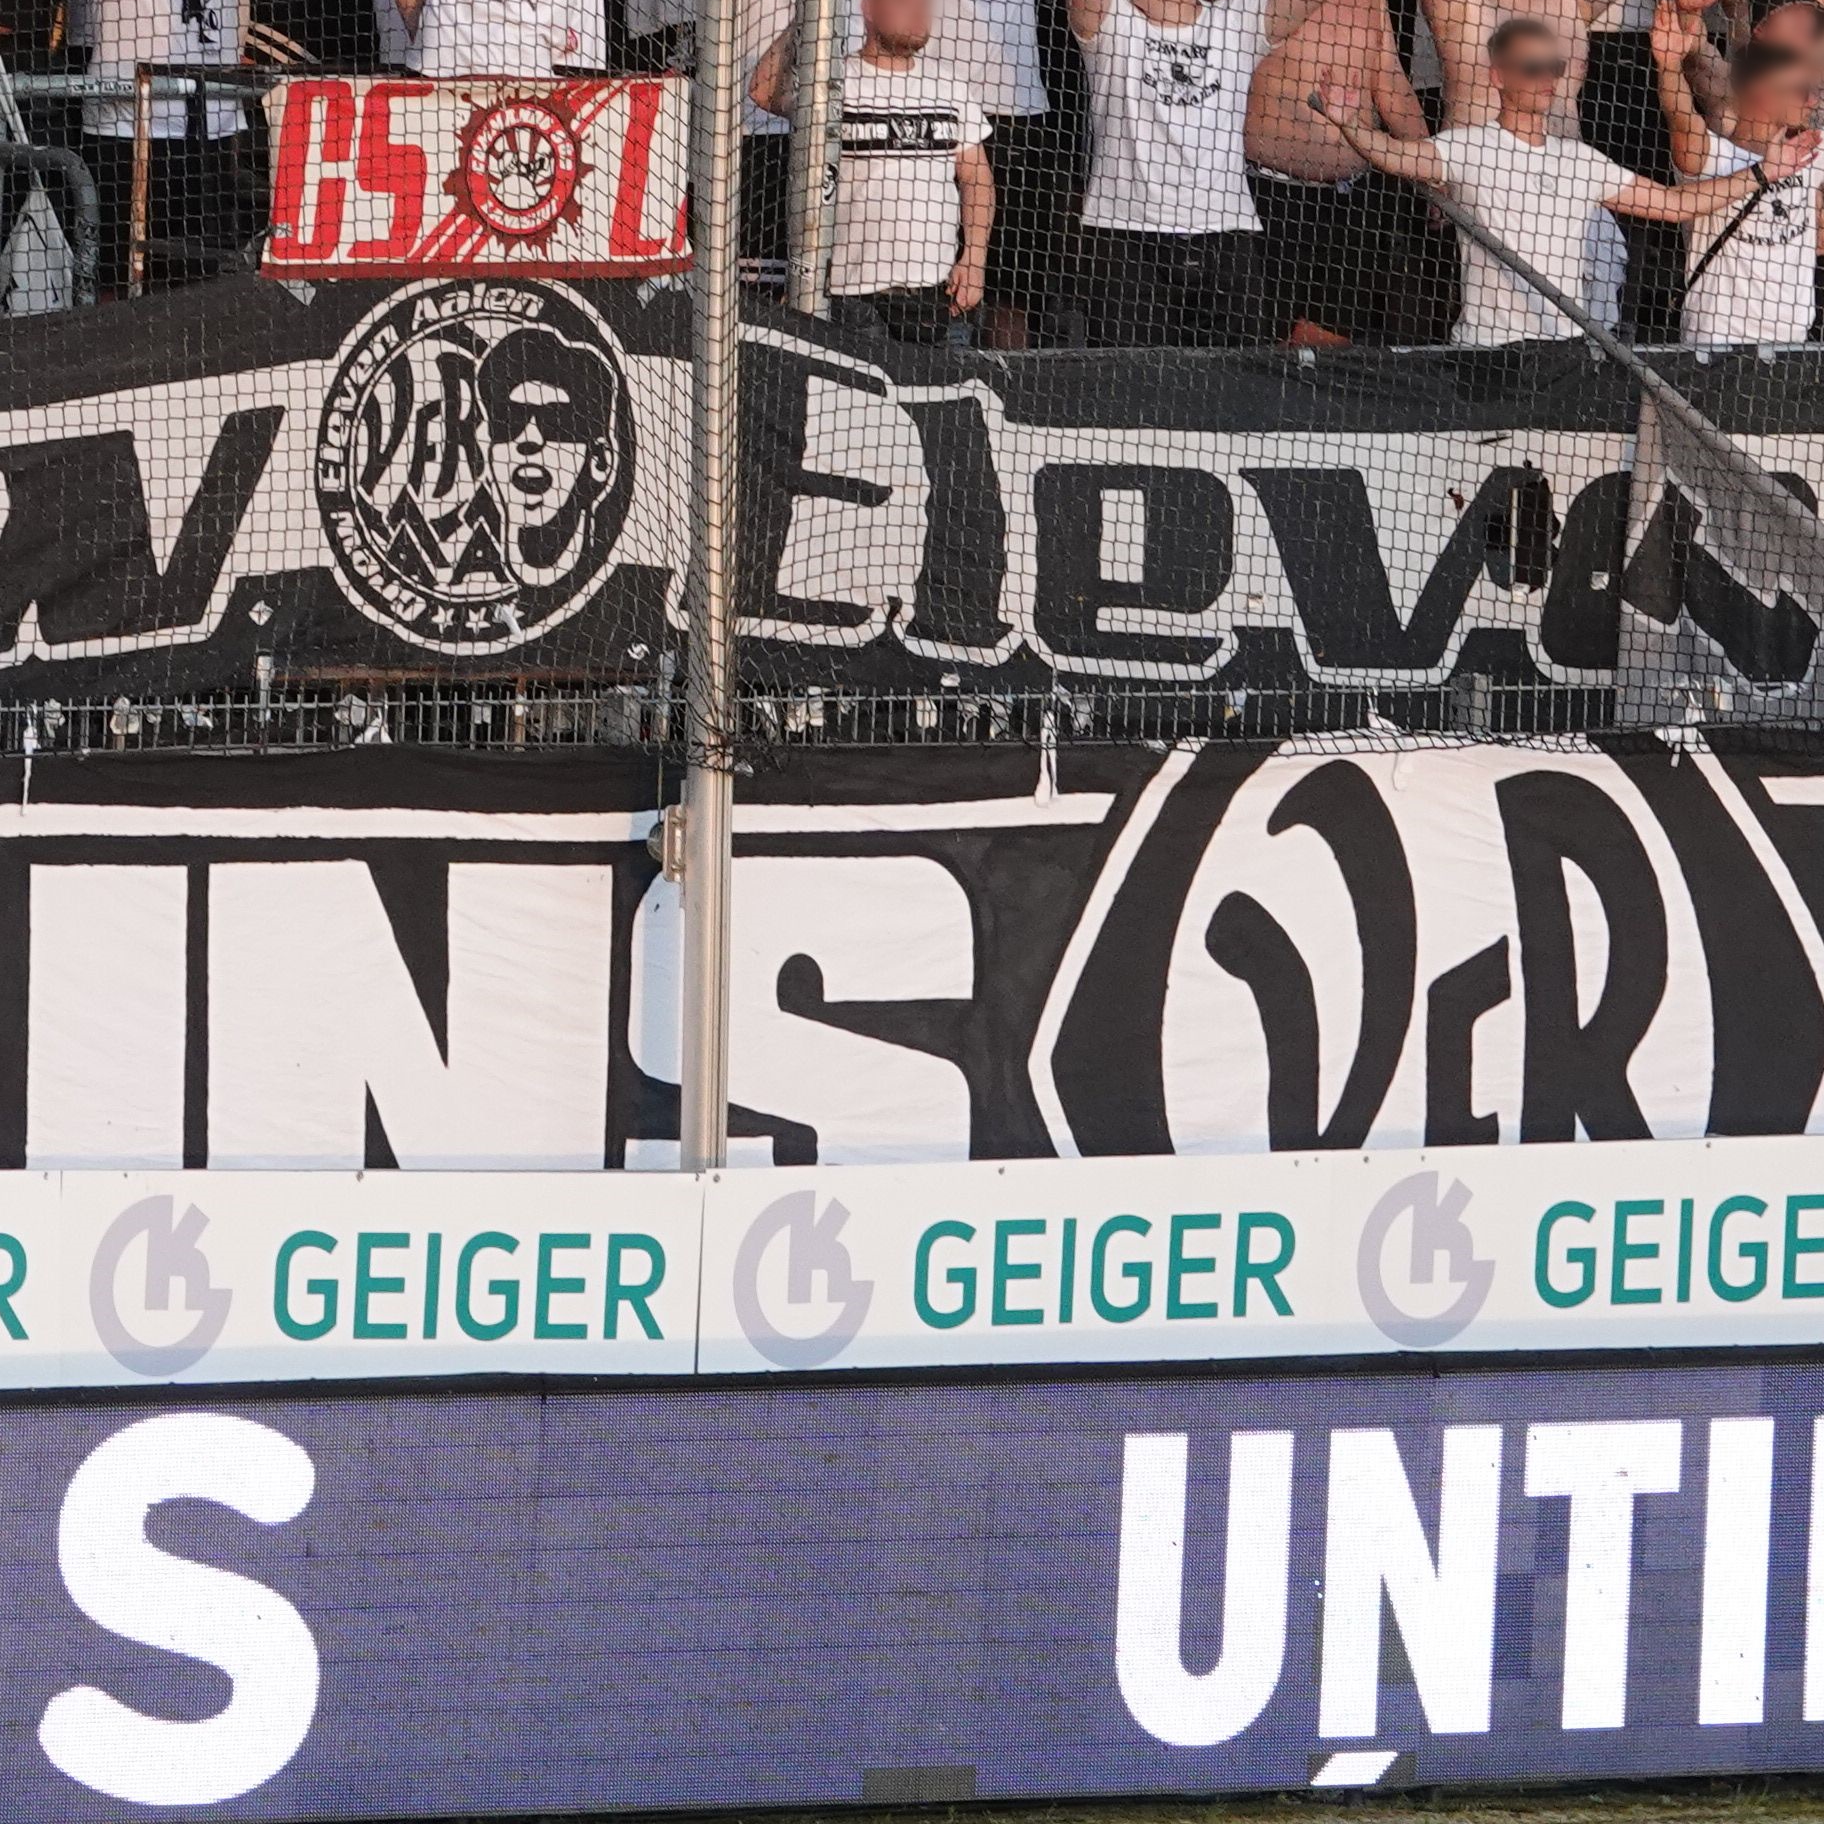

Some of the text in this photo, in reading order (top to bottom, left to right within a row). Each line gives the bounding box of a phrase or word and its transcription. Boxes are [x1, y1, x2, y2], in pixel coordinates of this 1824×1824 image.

[411, 281, 546, 332] Aalen
[274, 1228, 665, 1341] GEIGER
[913, 1211, 1296, 1329] GEIGER
